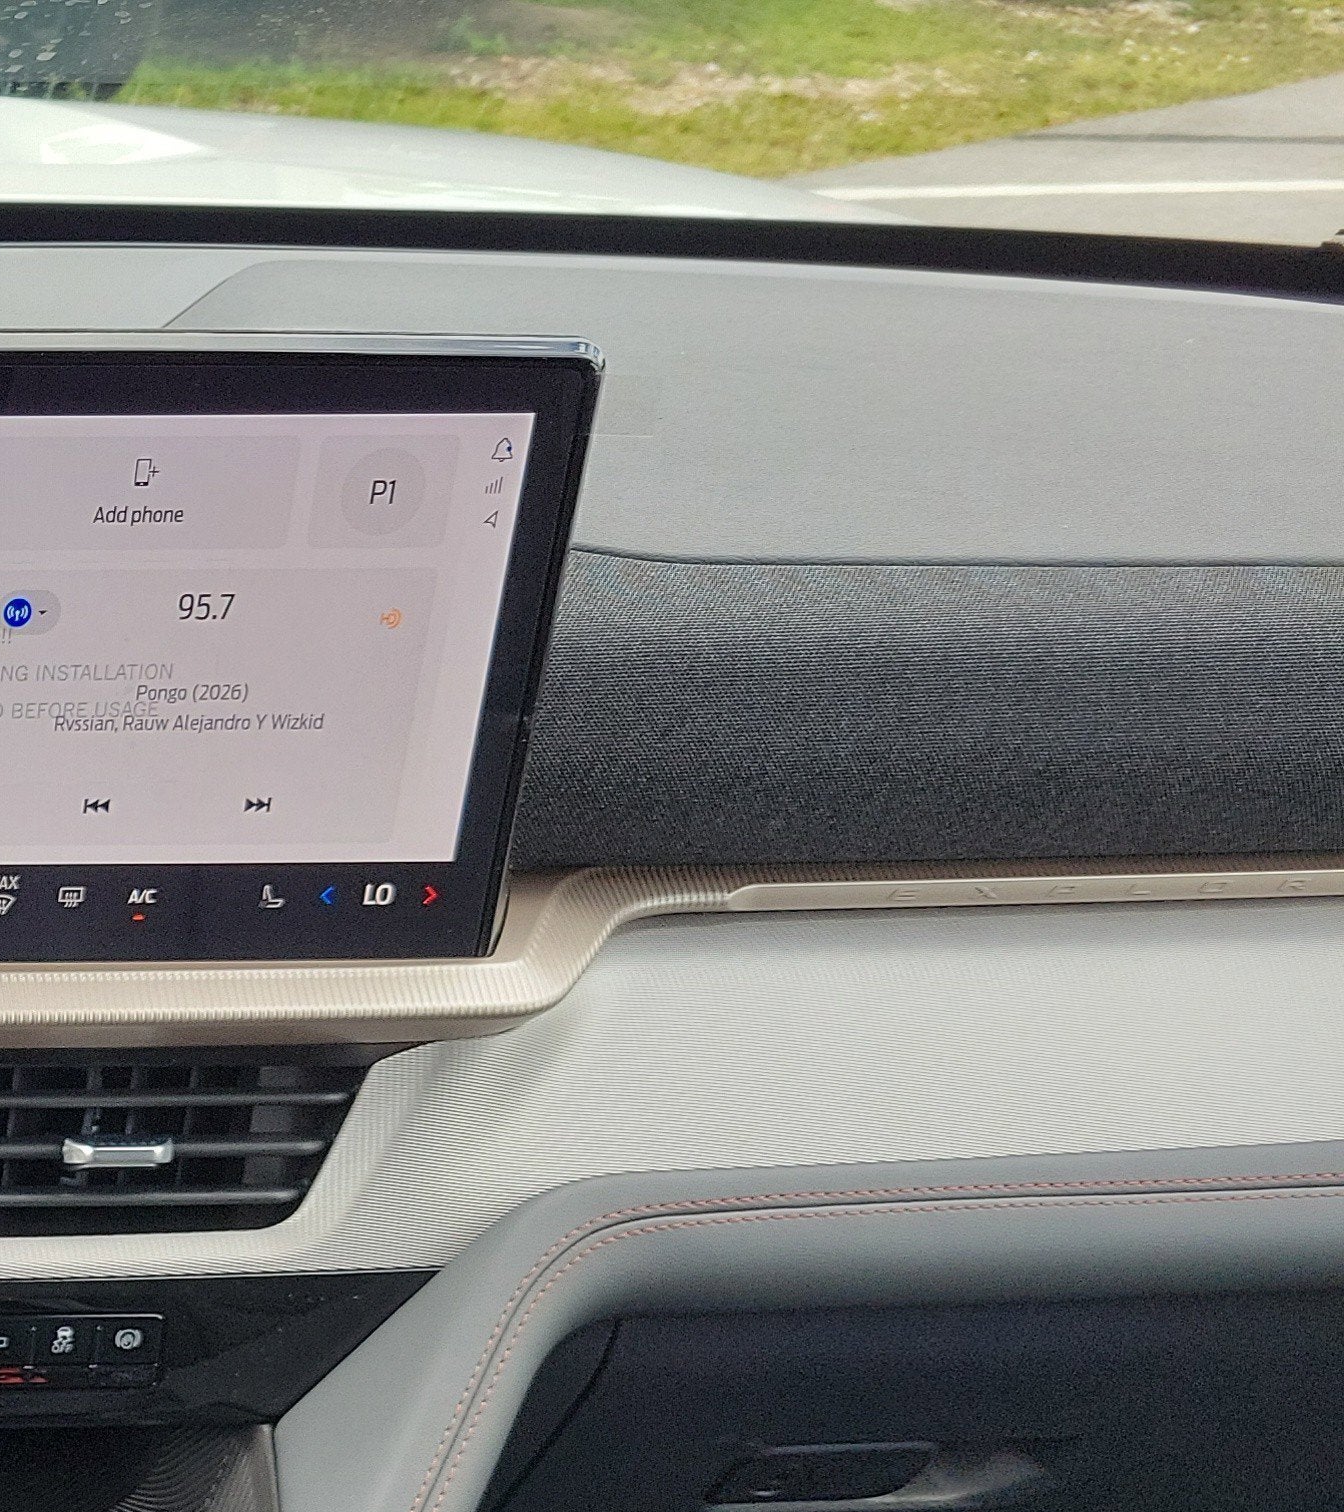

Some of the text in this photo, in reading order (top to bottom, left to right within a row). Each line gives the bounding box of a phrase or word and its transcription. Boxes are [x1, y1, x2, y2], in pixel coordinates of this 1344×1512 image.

[369, 480, 396, 504] P1
[93, 505, 184, 527] Add phone
[178, 593, 235, 620] 95.7
[34, 662, 175, 682] INSTALLATION
[135, 683, 249, 703] Pongo (2026)
[11, 701, 86, 720] BEFORE
[94, 700, 159, 719] USAGE
[122, 714, 167, 732] Rauw
[171, 714, 252, 735] Alejandro
[256, 713, 269, 731] Y
[270, 712, 325, 731] Wizkid
[127, 889, 157, 905] A/C
[362, 884, 396, 906] LO
